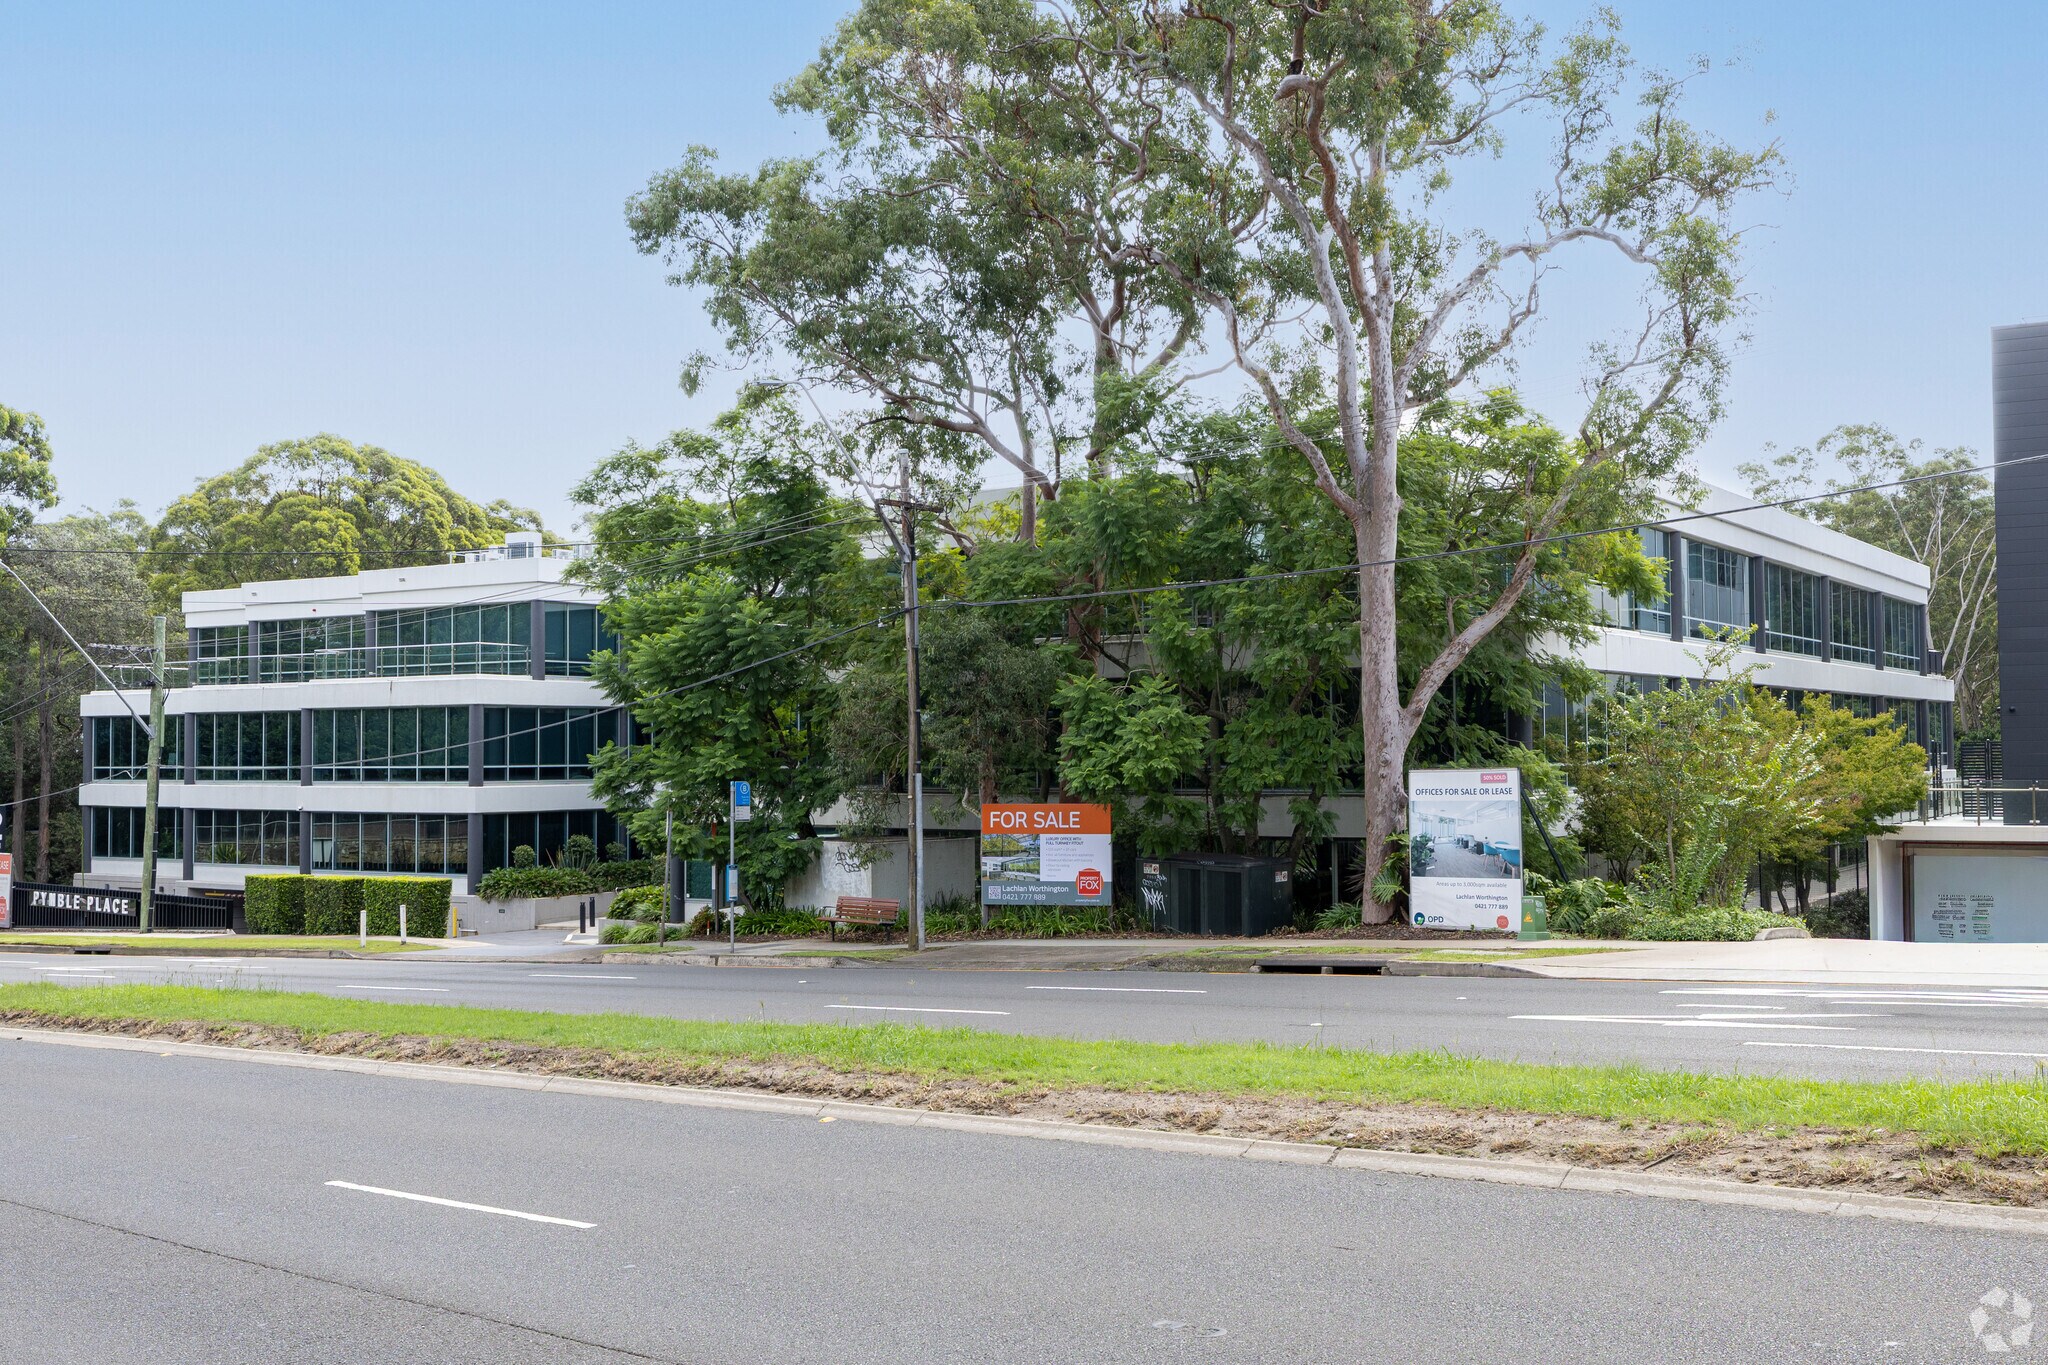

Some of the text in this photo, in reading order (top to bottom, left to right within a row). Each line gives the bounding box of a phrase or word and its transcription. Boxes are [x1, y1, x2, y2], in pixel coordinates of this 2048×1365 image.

[1415, 788, 1443, 796] OFFICES
[1492, 787, 1512, 795] LEASE
[990, 812, 1080, 828] FOR SALE
[0, 861, 8, 870] ASE
[1028, 885, 1069, 894] Worthington
[1080, 881, 1099, 889] FOX
[33, 891, 129, 915] PYMBLE PLACE
